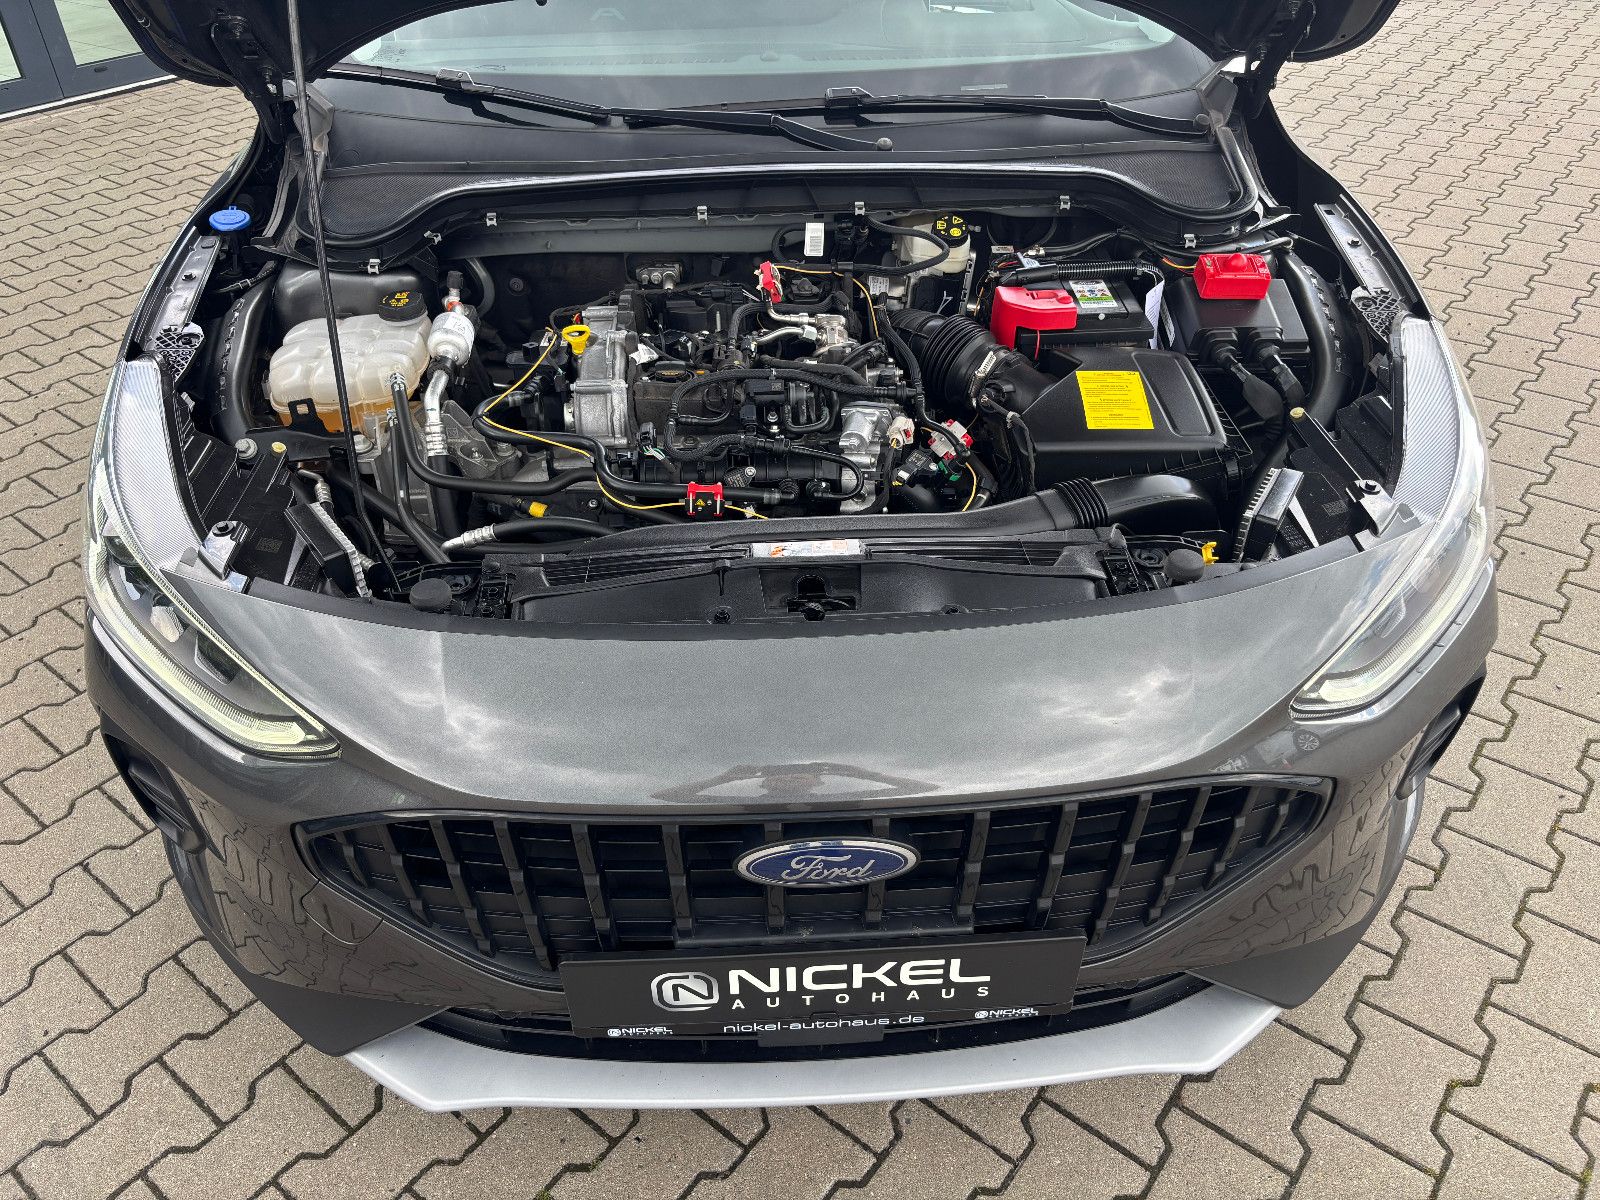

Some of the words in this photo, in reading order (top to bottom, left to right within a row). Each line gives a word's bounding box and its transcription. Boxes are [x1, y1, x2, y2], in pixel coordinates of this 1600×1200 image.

[781, 854, 876, 881] Ford
[728, 958, 991, 995] NICKEL
[731, 986, 989, 1010] AUTOHAUS
[989, 1007, 1039, 1016] NICKEL
[622, 1026, 673, 1034] NICKEL
[723, 1014, 925, 1033] nickel-autohaus.de
